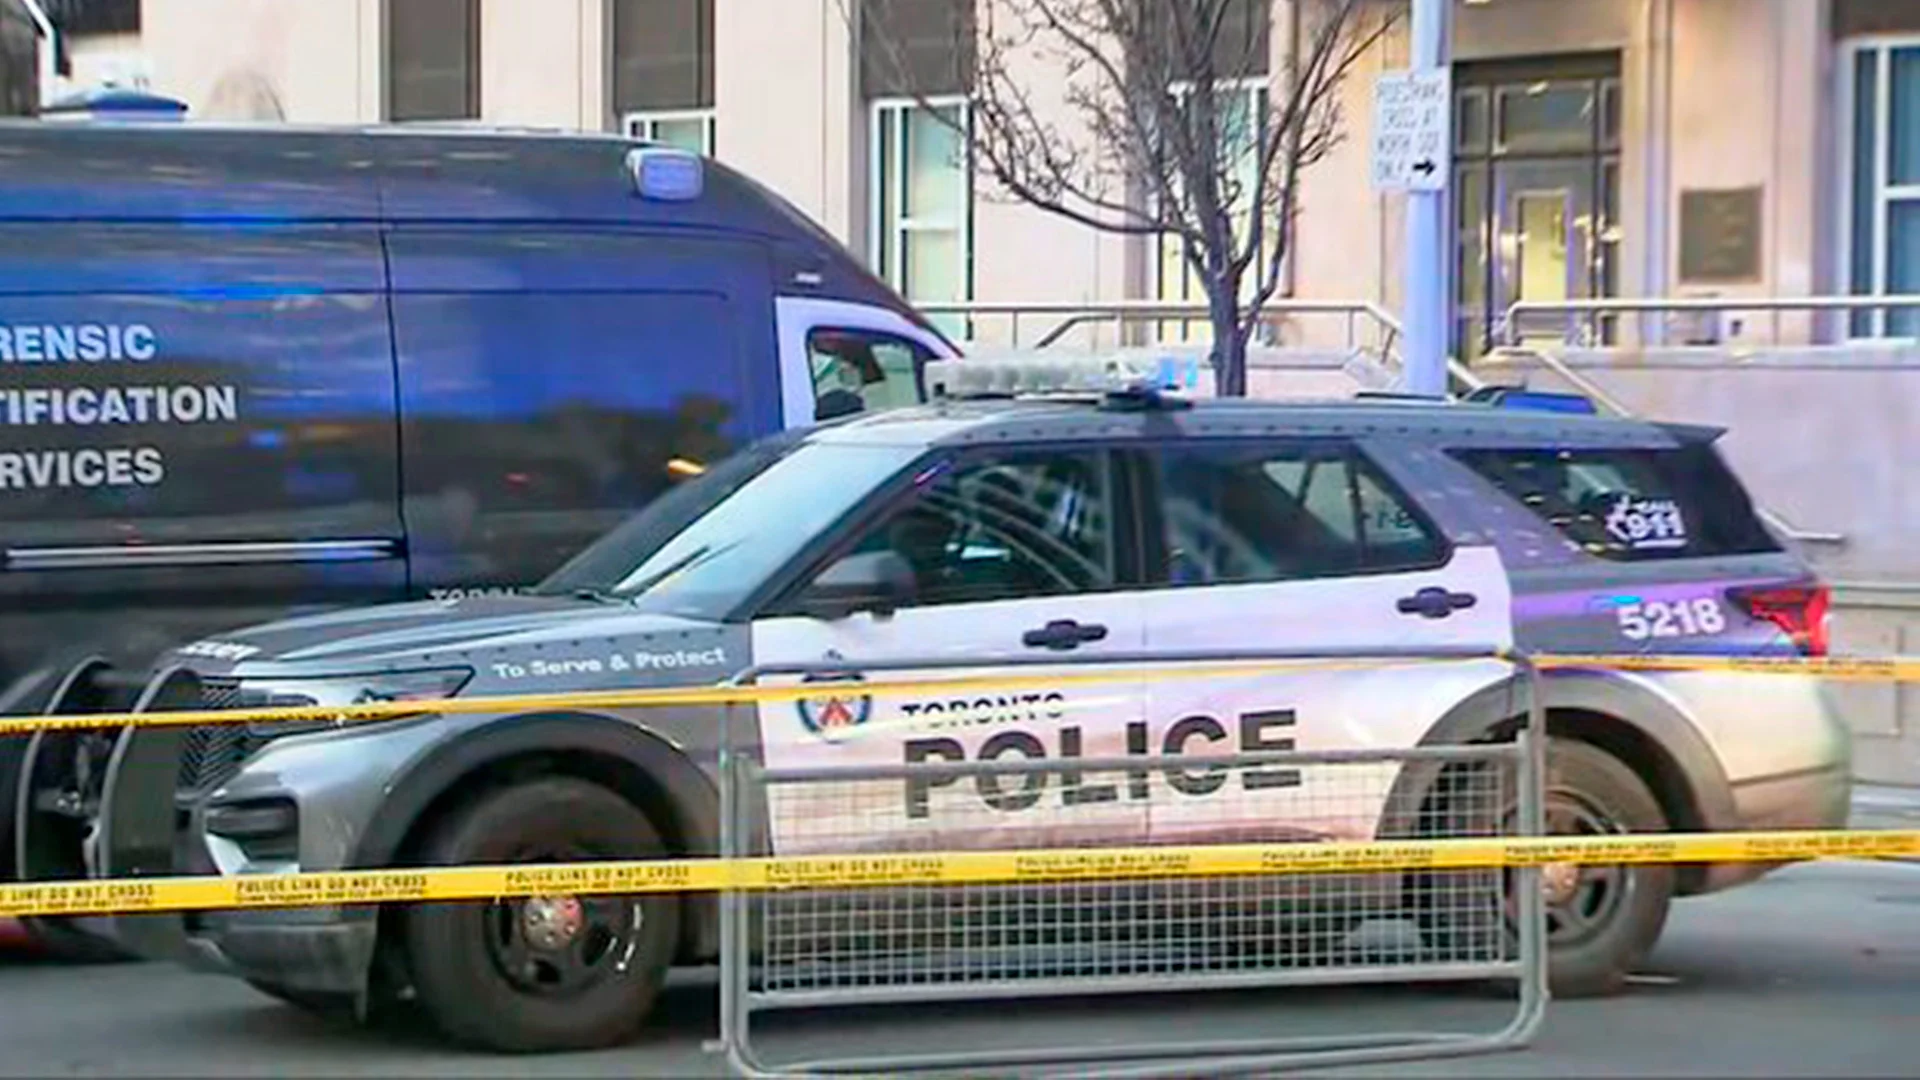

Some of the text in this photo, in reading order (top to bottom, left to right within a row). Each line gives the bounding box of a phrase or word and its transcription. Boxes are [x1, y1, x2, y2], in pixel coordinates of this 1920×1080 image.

[0, 385, 237, 425] IFICATION
[0, 448, 163, 488] RVICES
[1626, 512, 1685, 539] 911
[1617, 598, 1725, 640] 5218
[492, 647, 727, 679] To Serve & Protect
[903, 709, 1302, 819] POLICE
